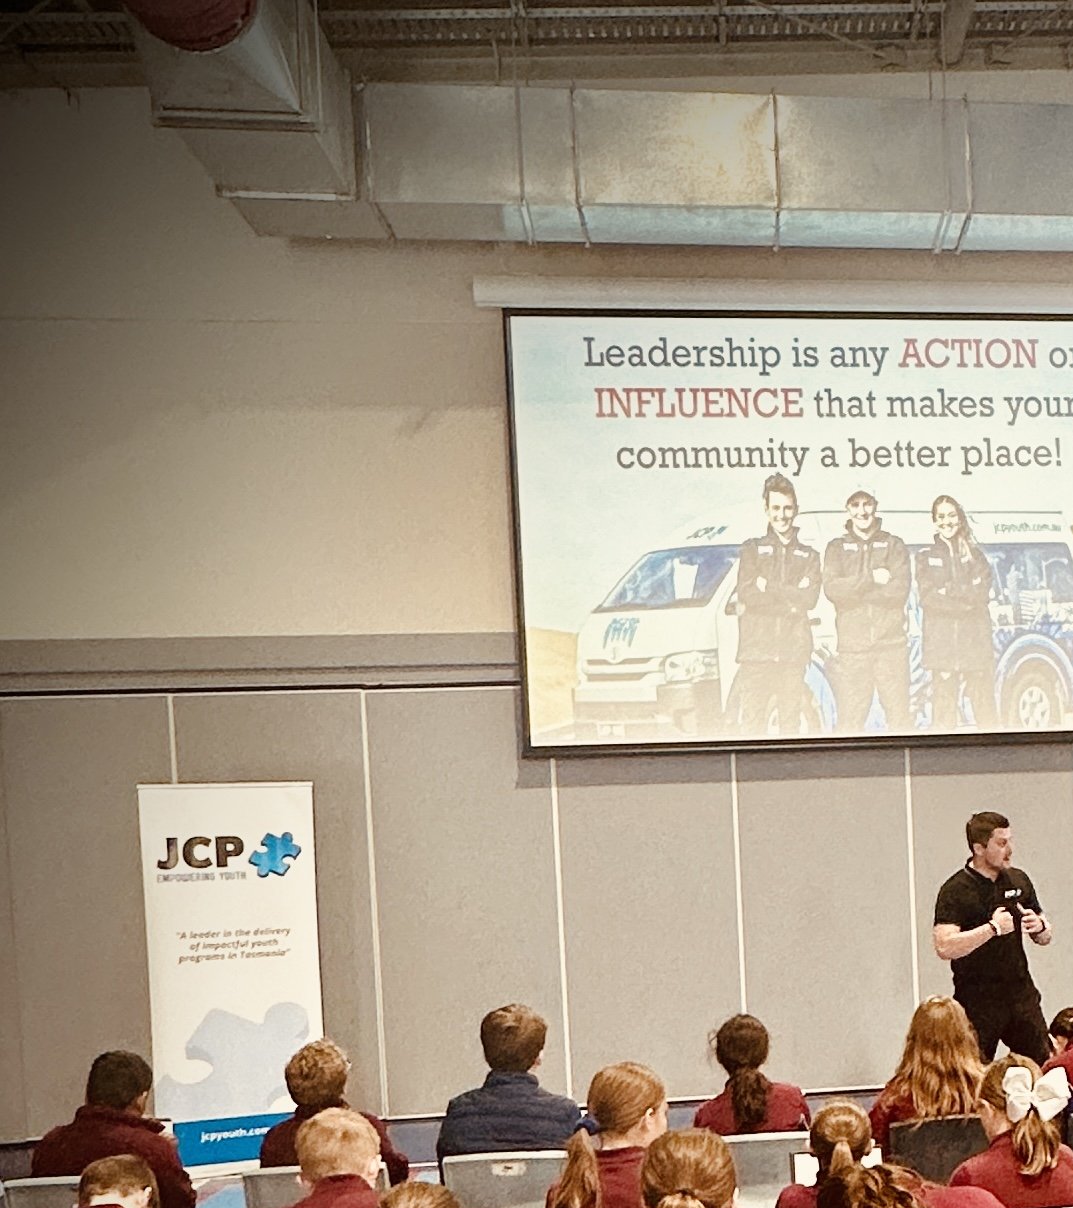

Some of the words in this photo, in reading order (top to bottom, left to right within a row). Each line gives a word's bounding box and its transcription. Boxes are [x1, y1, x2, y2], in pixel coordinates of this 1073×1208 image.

[583, 337, 781, 376] Leadership
[792, 337, 819, 367] is
[830, 345, 889, 376] any
[898, 338, 1039, 368] ACTION
[594, 387, 804, 418] INFLUENCE
[813, 388, 876, 418] that
[886, 388, 995, 418] makes
[616, 438, 810, 477] community
[820, 446, 839, 468] a
[848, 438, 951, 468] better
[960, 437, 1062, 475] place!
[157, 836, 244, 869] JCP
[157, 872, 215, 883] EMPOWERING
[219, 871, 247, 880] YOUTH
[189, 930, 221, 939] leader
[223, 929, 232, 938] in
[235, 928, 250, 937] the
[253, 927, 290, 936] delivery
[190, 942, 200, 952] of
[202, 940, 249, 951] impactful
[251, 939, 278, 949] youth
[178, 953, 225, 965] programs
[228, 951, 237, 960] in
